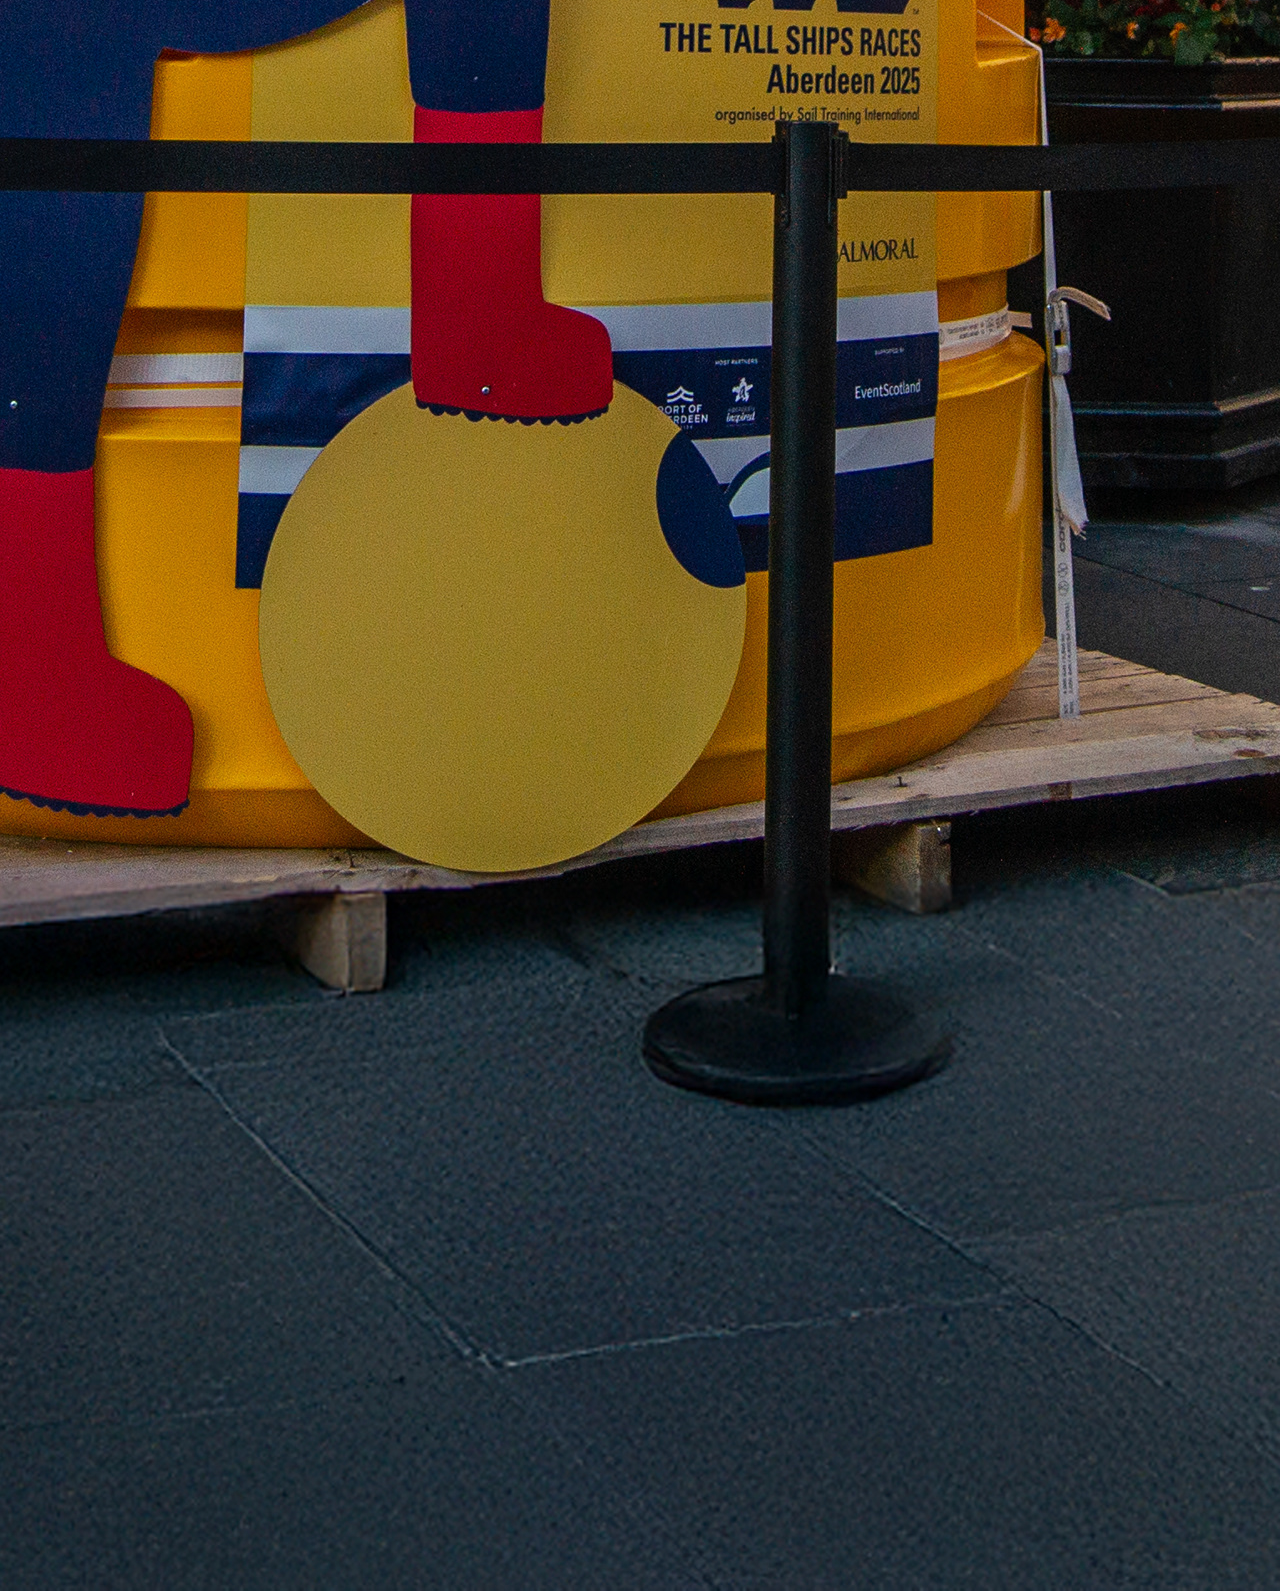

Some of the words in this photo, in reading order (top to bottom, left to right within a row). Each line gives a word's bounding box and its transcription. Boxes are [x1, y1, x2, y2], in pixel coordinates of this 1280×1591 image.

[659, 22, 712, 52] THE
[719, 24, 779, 54] TALL
[786, 25, 854, 55] SHIPS
[860, 28, 922, 57] RACES
[766, 64, 875, 94] Aberdeen
[880, 67, 921, 95] 2025
[715, 106, 775, 124] organised
[779, 106, 794, 121] by
[797, 107, 818, 121] Sail
[820, 107, 861, 124] Training
[864, 107, 920, 121] International
[837, 238, 919, 263] ALMORAL
[854, 379, 922, 400] EventScotland
[669, 414, 709, 424] RDEEN
[688, 404, 703, 413] OF
